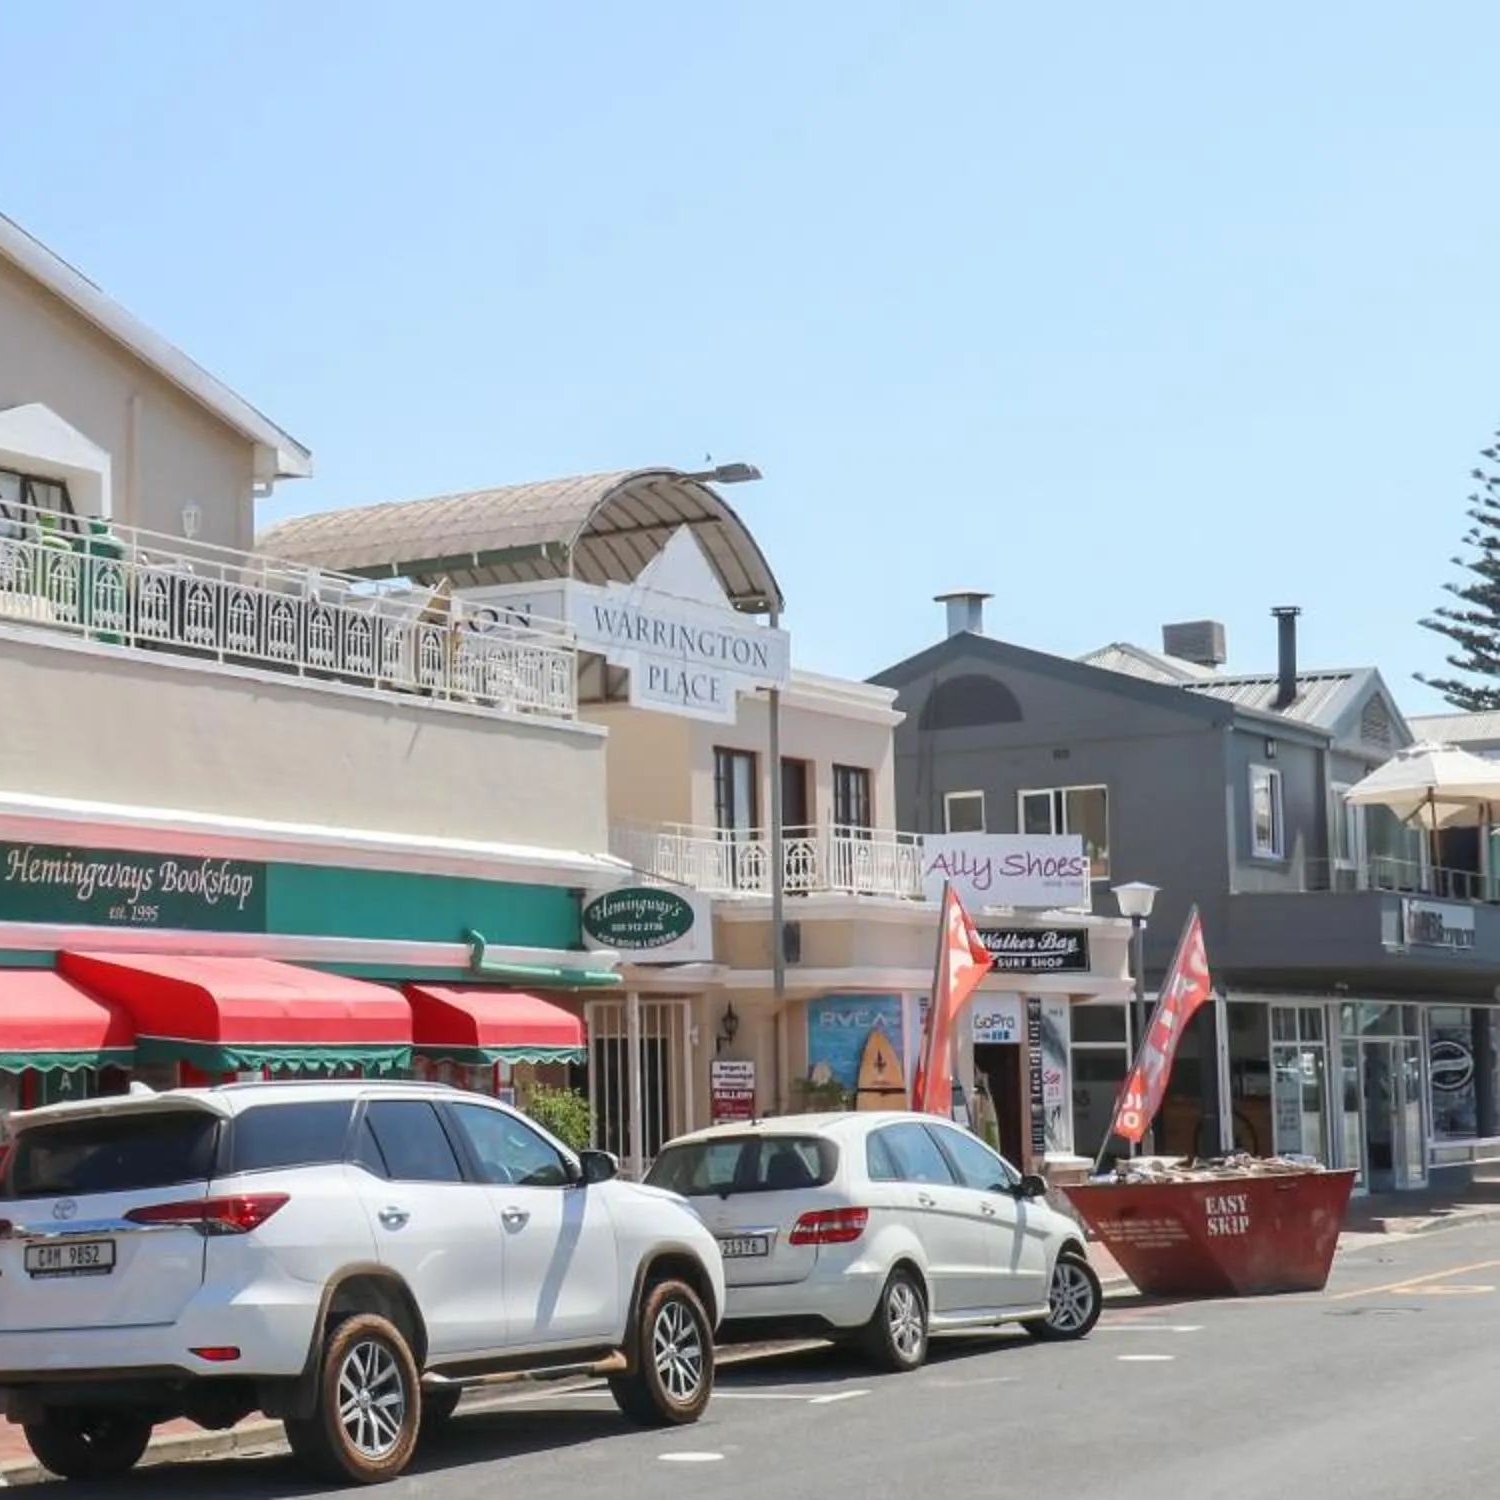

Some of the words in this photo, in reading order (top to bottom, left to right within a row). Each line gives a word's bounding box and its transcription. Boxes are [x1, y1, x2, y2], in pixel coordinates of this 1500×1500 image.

[593, 605, 769, 669] WARRINGTON
[648, 665, 722, 704] PLACE
[5, 845, 155, 903] Hemingways
[159, 858, 253, 910] Bookshop
[927, 851, 991, 890] Ally
[1000, 852, 1083, 877] Shoes
[109, 905, 127, 920] est.
[131, 904, 159, 922] 1995
[590, 894, 683, 921] Hemingway's
[981, 932, 1036, 950] Walker
[1038, 931, 1079, 953] Bay
[1031, 957, 1064, 967] SHOP
[974, 1013, 1015, 1029] GoPro
[1205, 1195, 1248, 1215] EASY
[1207, 1215, 1250, 1236] SKIP
